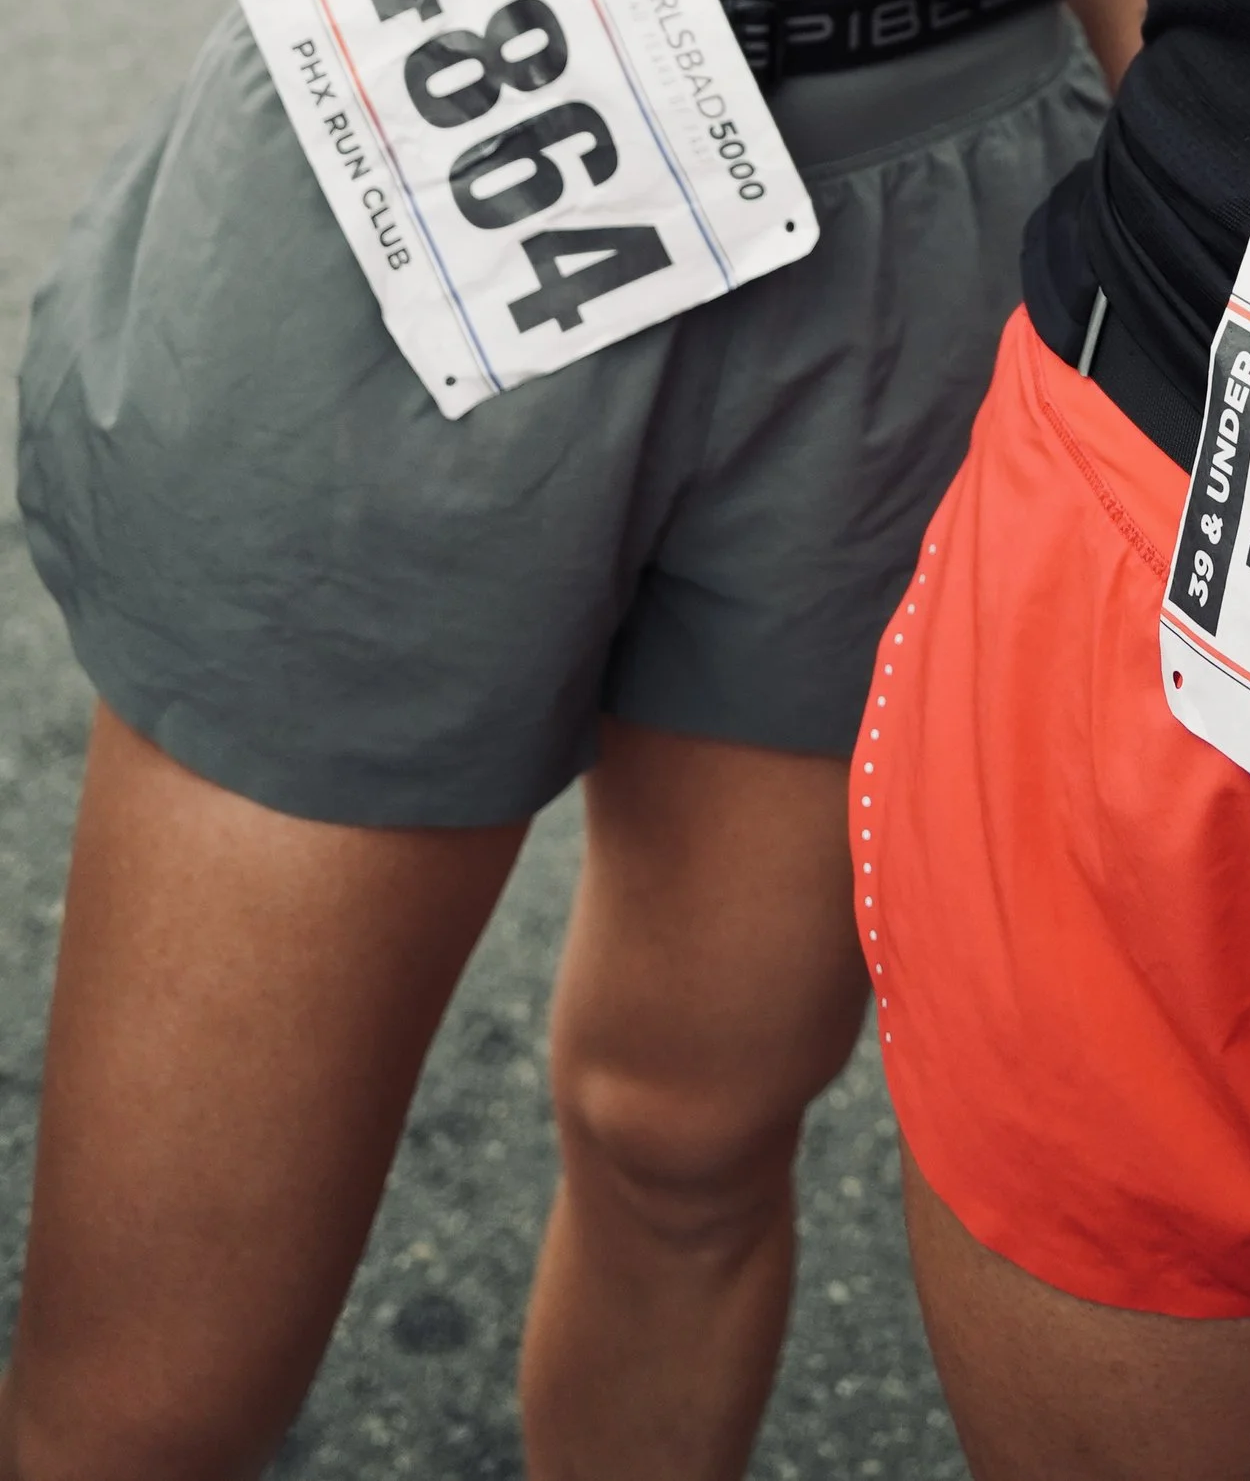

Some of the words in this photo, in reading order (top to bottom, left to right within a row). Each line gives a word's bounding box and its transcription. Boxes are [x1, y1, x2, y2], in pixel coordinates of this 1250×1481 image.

[292, 39, 336, 106] PHX
[324, 111, 372, 181] RUN
[362, 188, 411, 271] CLUB
[1188, 550, 1214, 607] 39
[1201, 513, 1224, 545] &
